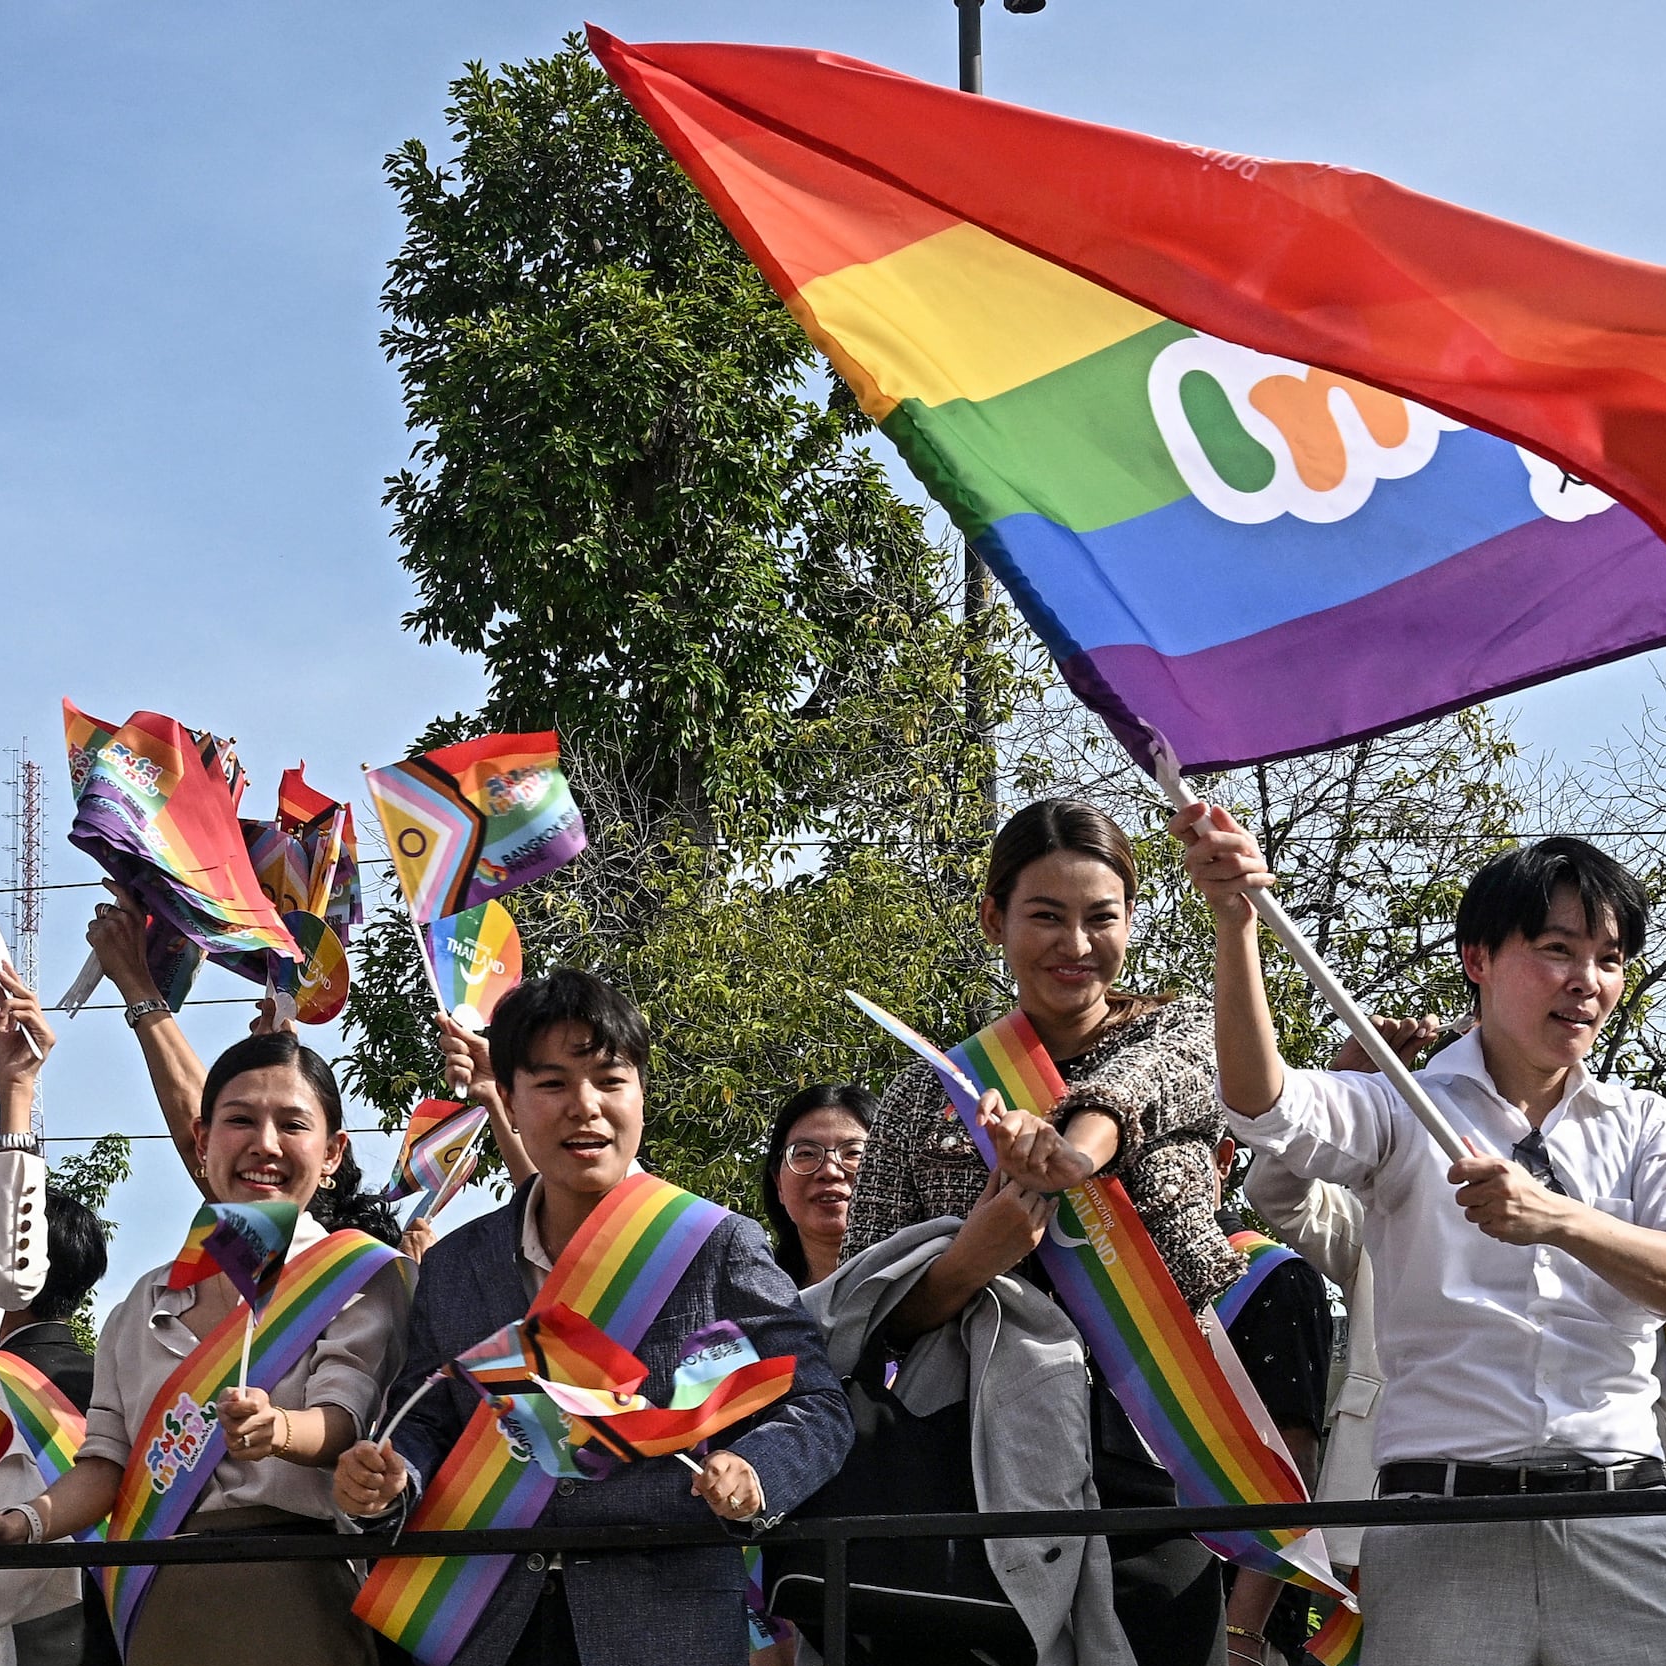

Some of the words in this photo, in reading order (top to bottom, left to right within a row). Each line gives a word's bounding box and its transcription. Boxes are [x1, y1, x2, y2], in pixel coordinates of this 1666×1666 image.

[446, 936, 506, 975] THAILAND
[1063, 1188, 1118, 1266] AILAND
[1085, 1179, 1115, 1231] amazing
